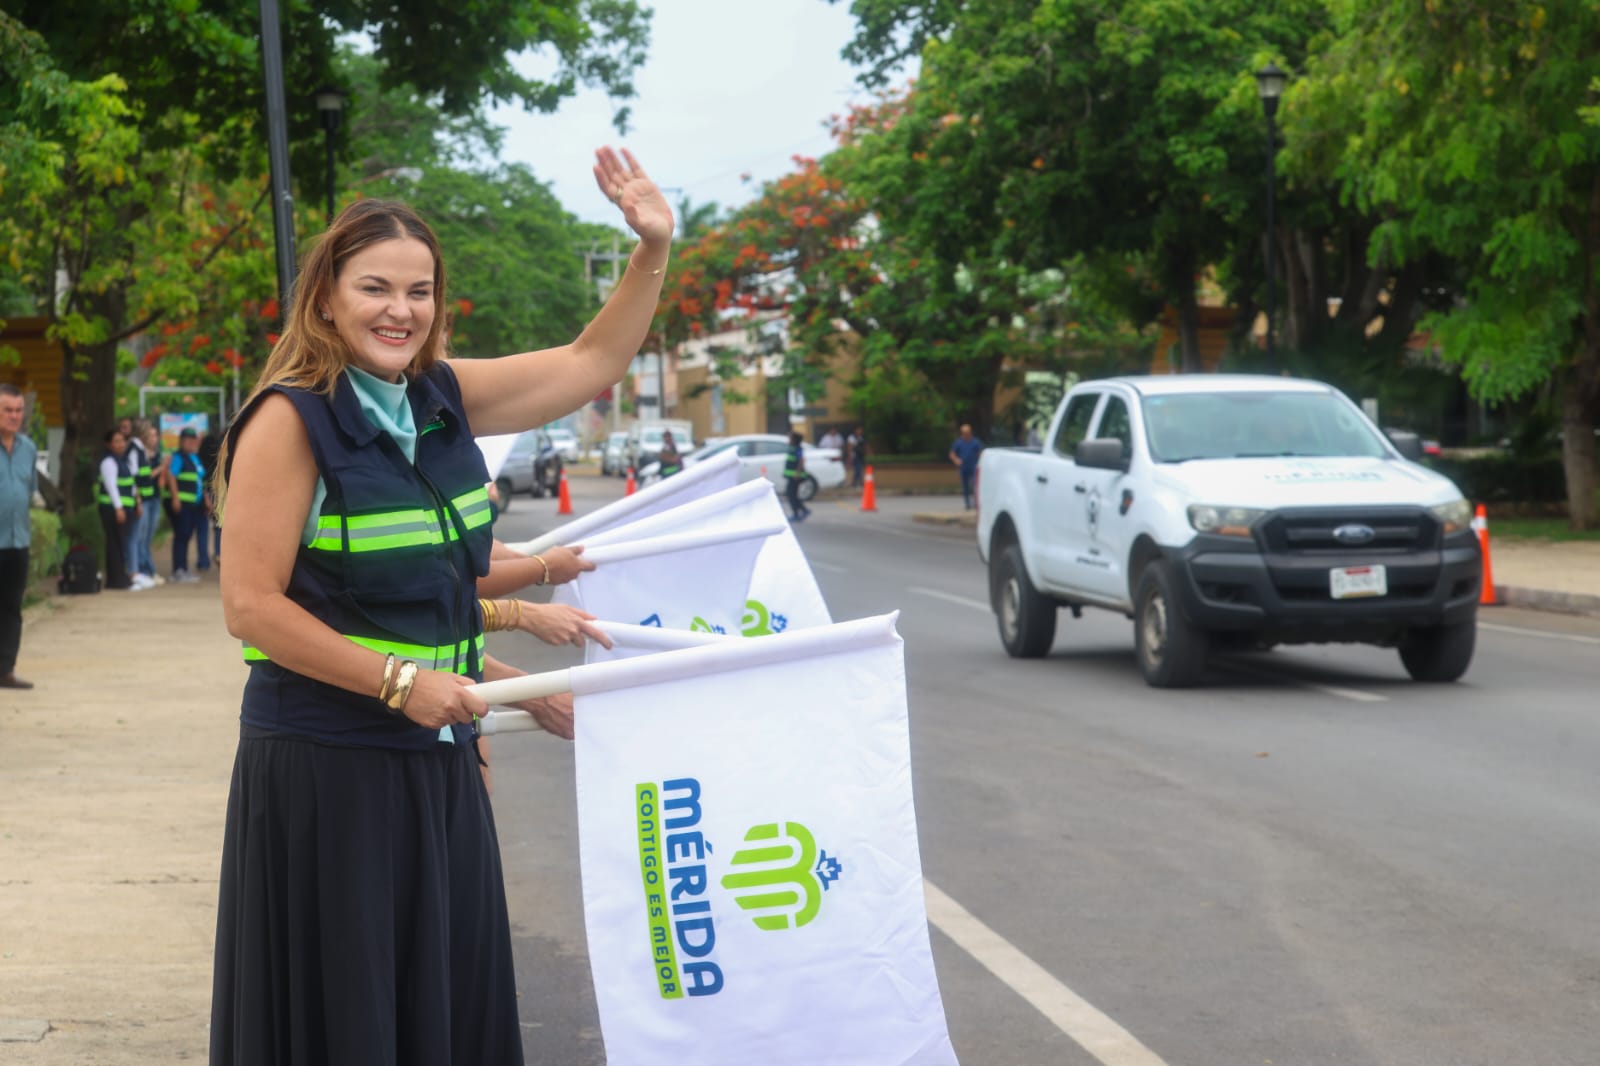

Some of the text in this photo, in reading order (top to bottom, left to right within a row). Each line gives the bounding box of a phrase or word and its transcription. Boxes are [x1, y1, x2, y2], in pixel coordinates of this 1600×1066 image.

[640, 789, 676, 994] CONTIGO ES MEJOR
[663, 778, 724, 996] MÉRIDA
